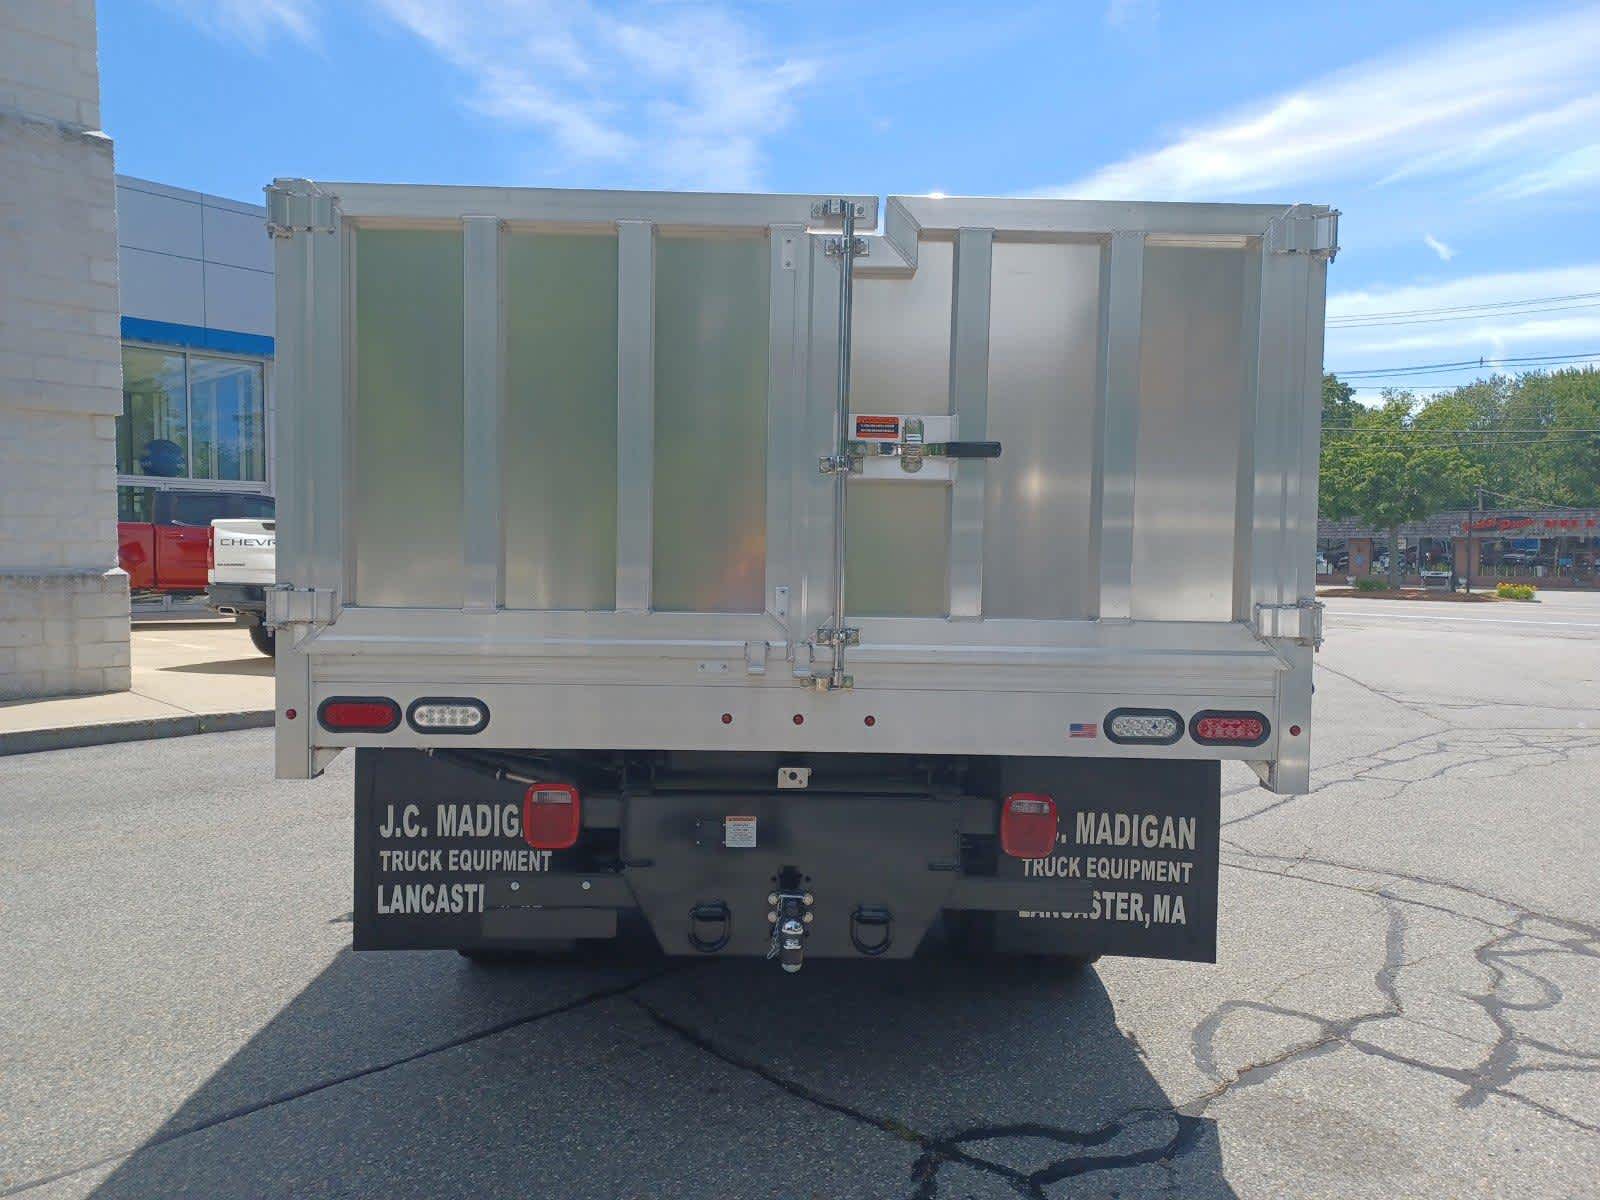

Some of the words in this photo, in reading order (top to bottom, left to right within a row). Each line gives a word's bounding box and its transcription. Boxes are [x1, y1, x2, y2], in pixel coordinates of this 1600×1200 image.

[379, 803, 428, 838] J.C.
[437, 803, 524, 838] MADIG
[1075, 811, 1196, 850] MADIGAN
[379, 850, 443, 872] TRUCK
[448, 850, 553, 872] EQUIPMENT
[1021, 856, 1081, 878] TRUCK
[1086, 856, 1193, 884] EQUIPMENT
[1018, 890, 1187, 929] STER,MA
